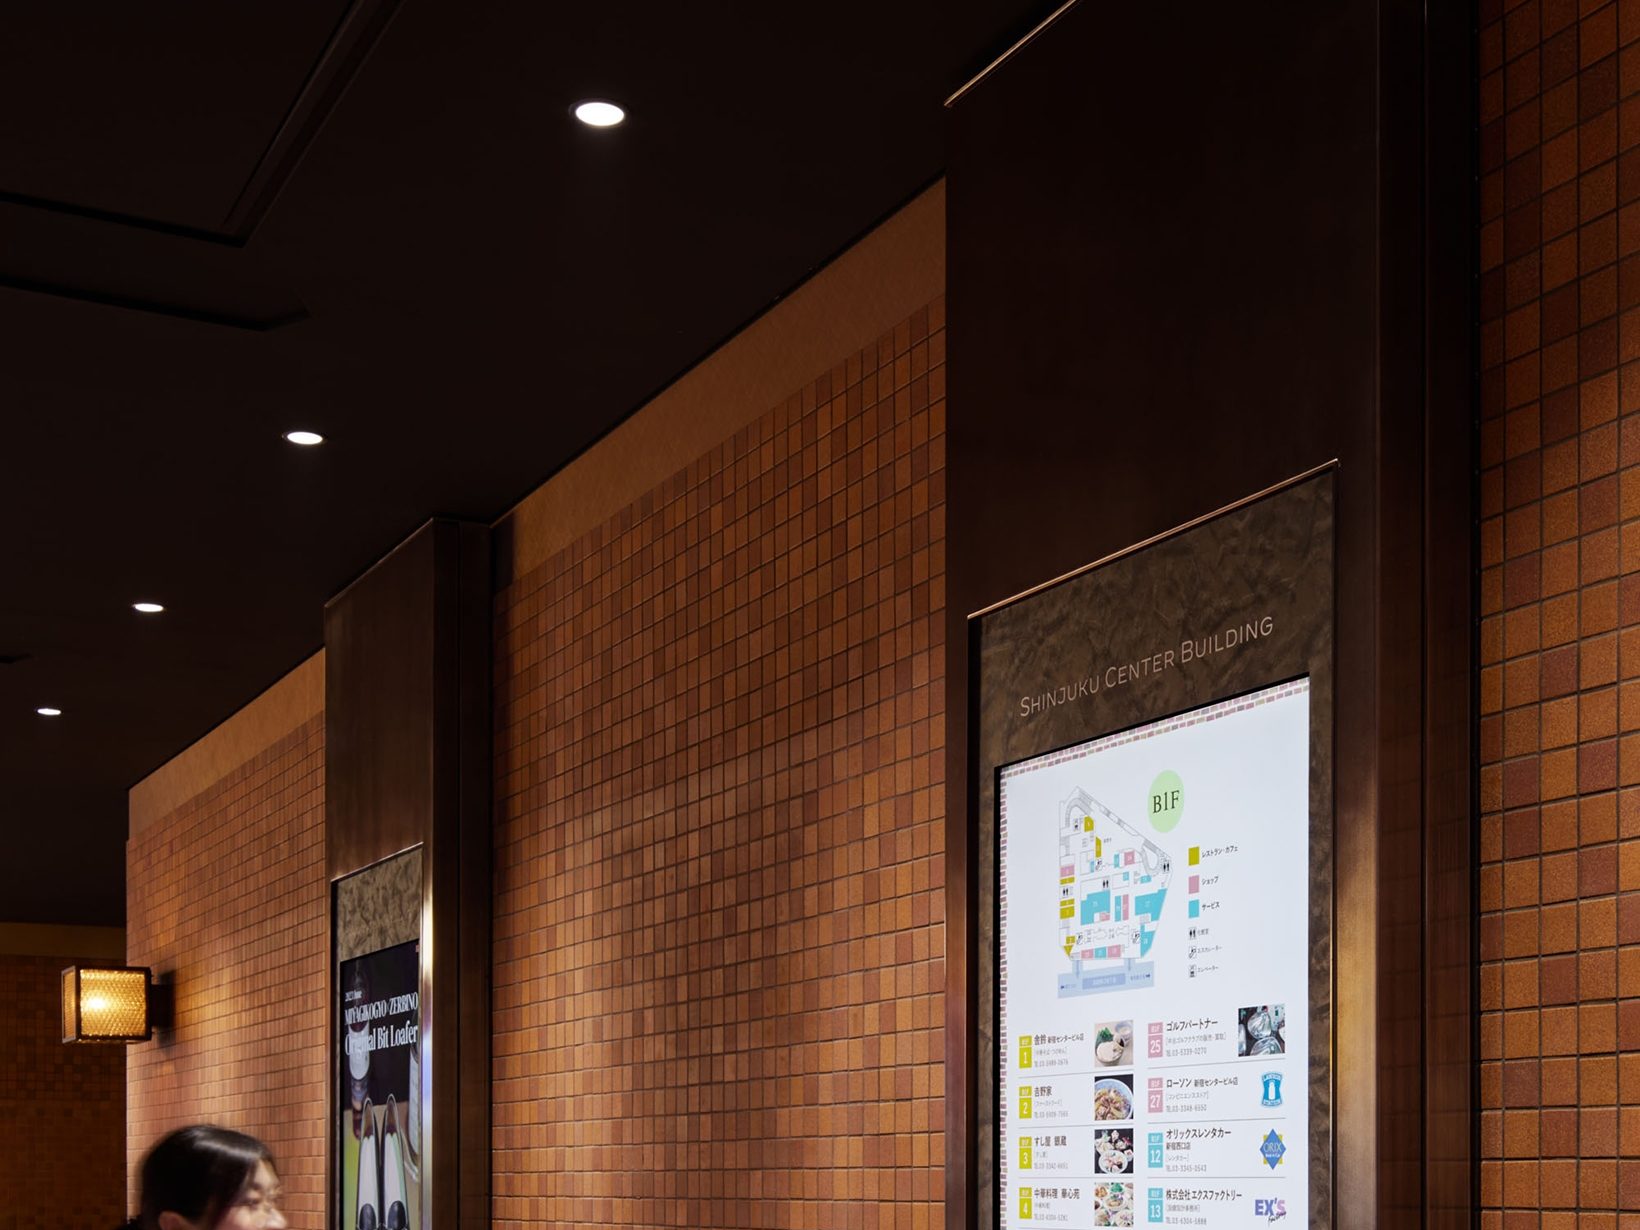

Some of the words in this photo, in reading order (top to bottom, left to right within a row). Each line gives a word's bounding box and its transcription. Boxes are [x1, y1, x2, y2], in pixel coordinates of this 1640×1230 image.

[1020, 675, 1100, 717] SHINJUKU
[1105, 650, 1174, 688] CENTER
[1181, 616, 1274, 664] BUILDING
[1153, 790, 1180, 814] B1F
[1202, 876, 1219, 886] ショップ
[1202, 902, 1220, 911] サービス
[1167, 1018, 1218, 1031] ゴルフパートナー
[378, 1026, 389, 1049] Bit
[390, 1020, 418, 1047] Loafer
[1150, 1040, 1160, 1053] 25
[1167, 1079, 1192, 1088] ローソン
[1150, 1095, 1160, 1108] 27
[1166, 1127, 1231, 1140] オリックスレンタカー
[1150, 1150, 1160, 1163] 12
[1192, 1190, 1242, 1200] エクスファクトリー
[1150, 1205, 1160, 1218] 13
